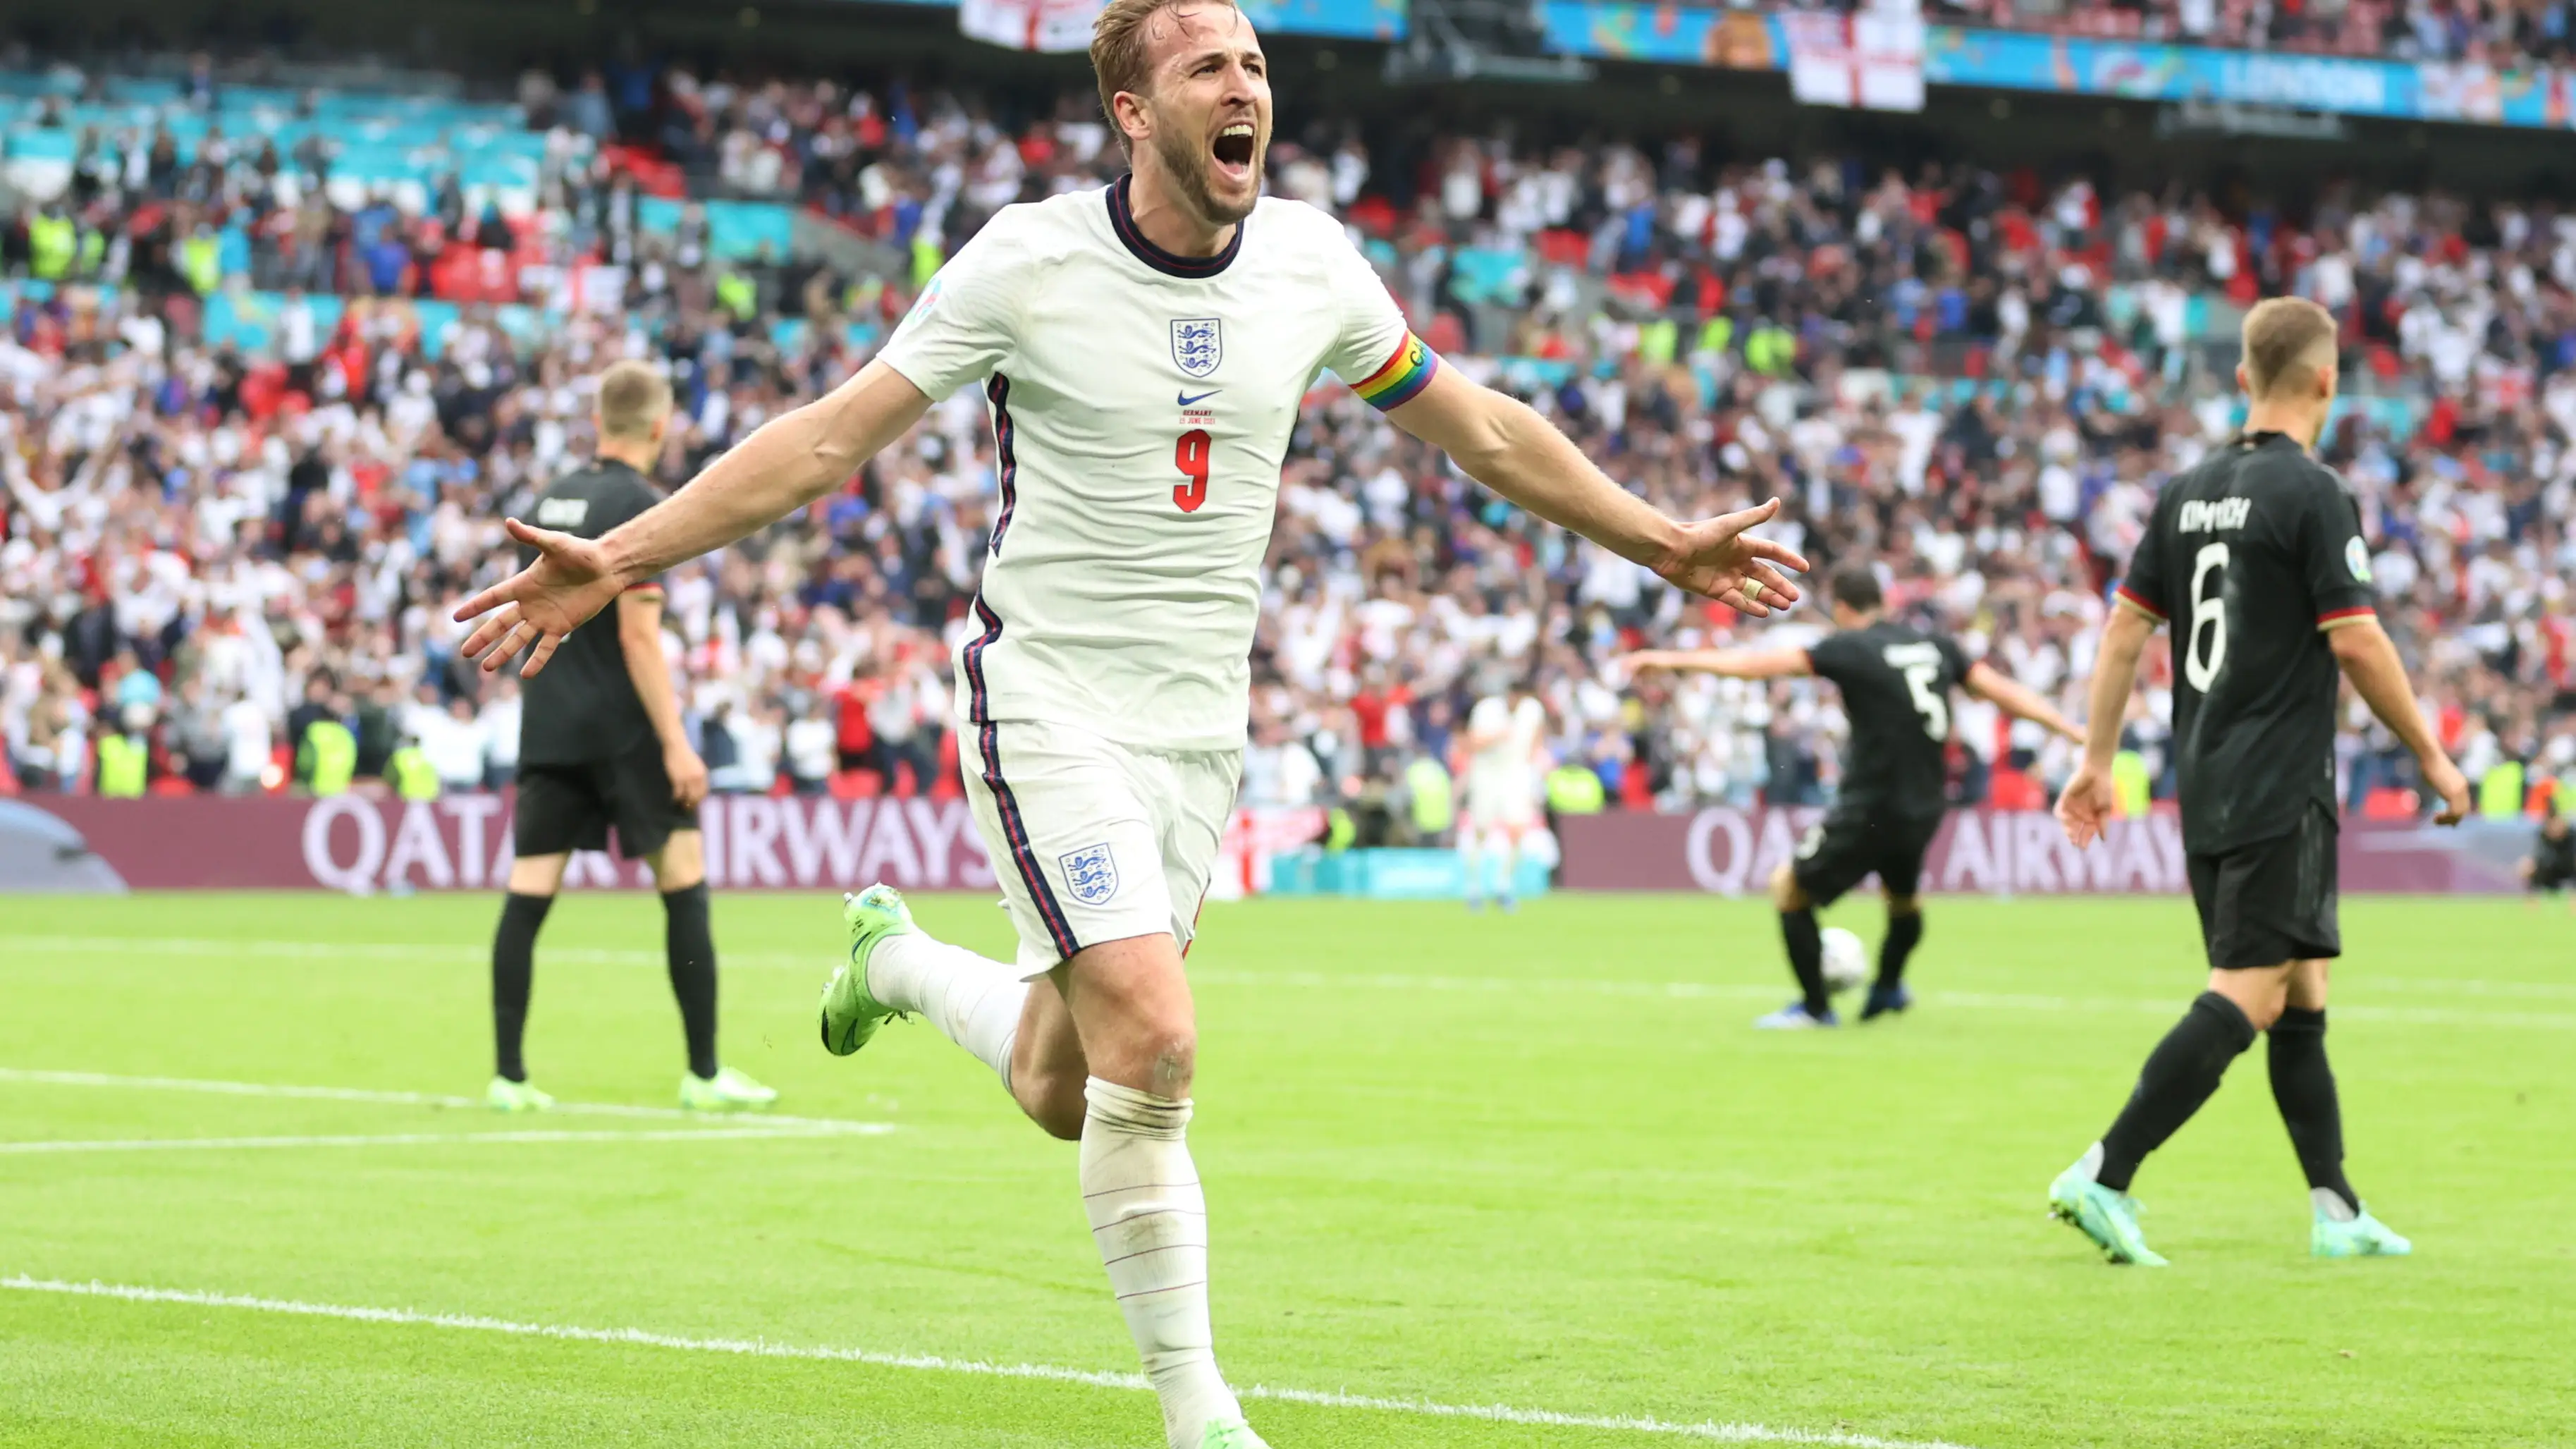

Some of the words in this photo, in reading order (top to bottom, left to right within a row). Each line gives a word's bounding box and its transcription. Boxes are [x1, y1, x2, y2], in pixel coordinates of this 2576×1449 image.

[1173, 429, 1212, 513] 9
[2185, 542, 2230, 694] 6
[1905, 663, 1949, 742] 5
[634, 795, 995, 888] IRWAYS
[1943, 809, 2188, 890] AIRWAY
